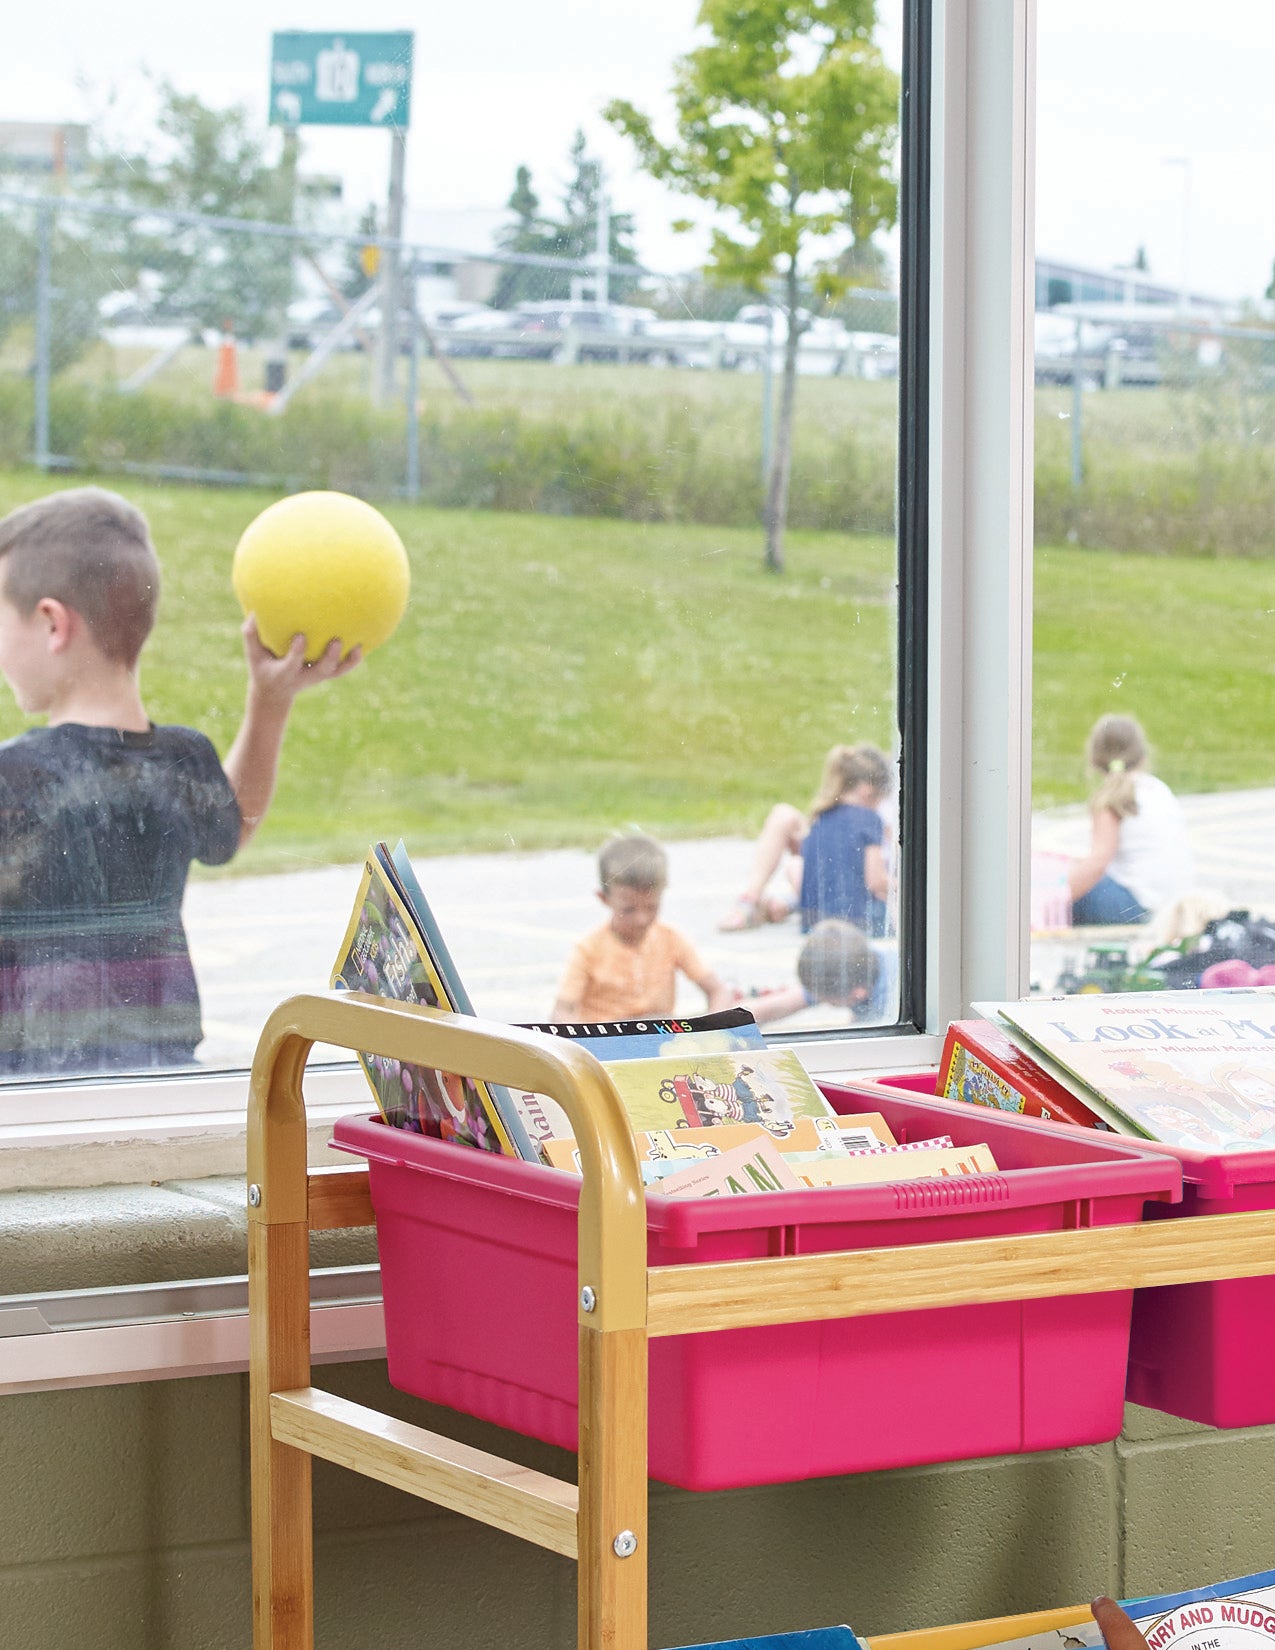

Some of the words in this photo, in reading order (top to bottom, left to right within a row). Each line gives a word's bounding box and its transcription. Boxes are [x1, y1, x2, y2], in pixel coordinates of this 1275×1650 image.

[383, 922, 412, 997] Fish!
[653, 1020, 693, 1035] kids
[1047, 1018, 1199, 1043] Look
[1181, 1607, 1214, 1630] AND
[1202, 1638, 1221, 1650] THE
